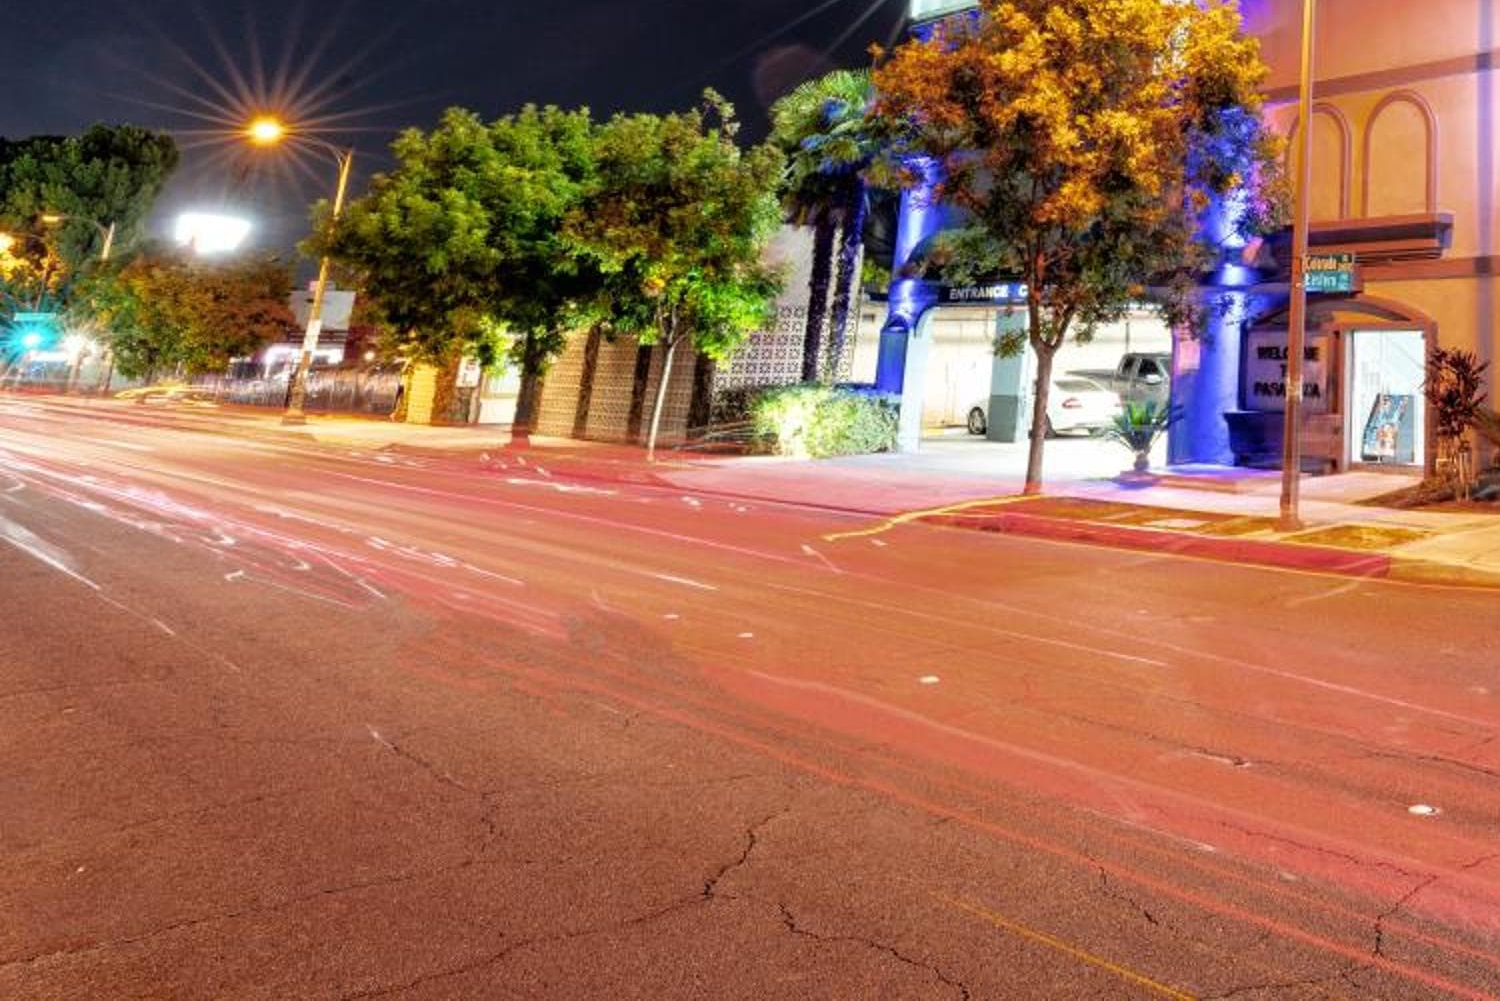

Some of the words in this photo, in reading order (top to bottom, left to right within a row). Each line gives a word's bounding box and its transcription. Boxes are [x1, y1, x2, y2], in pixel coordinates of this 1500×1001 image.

[949, 284, 1008, 299] ENTRANCE
[1257, 346, 1320, 360] WELCME
[1254, 382, 1321, 397] PASANA
